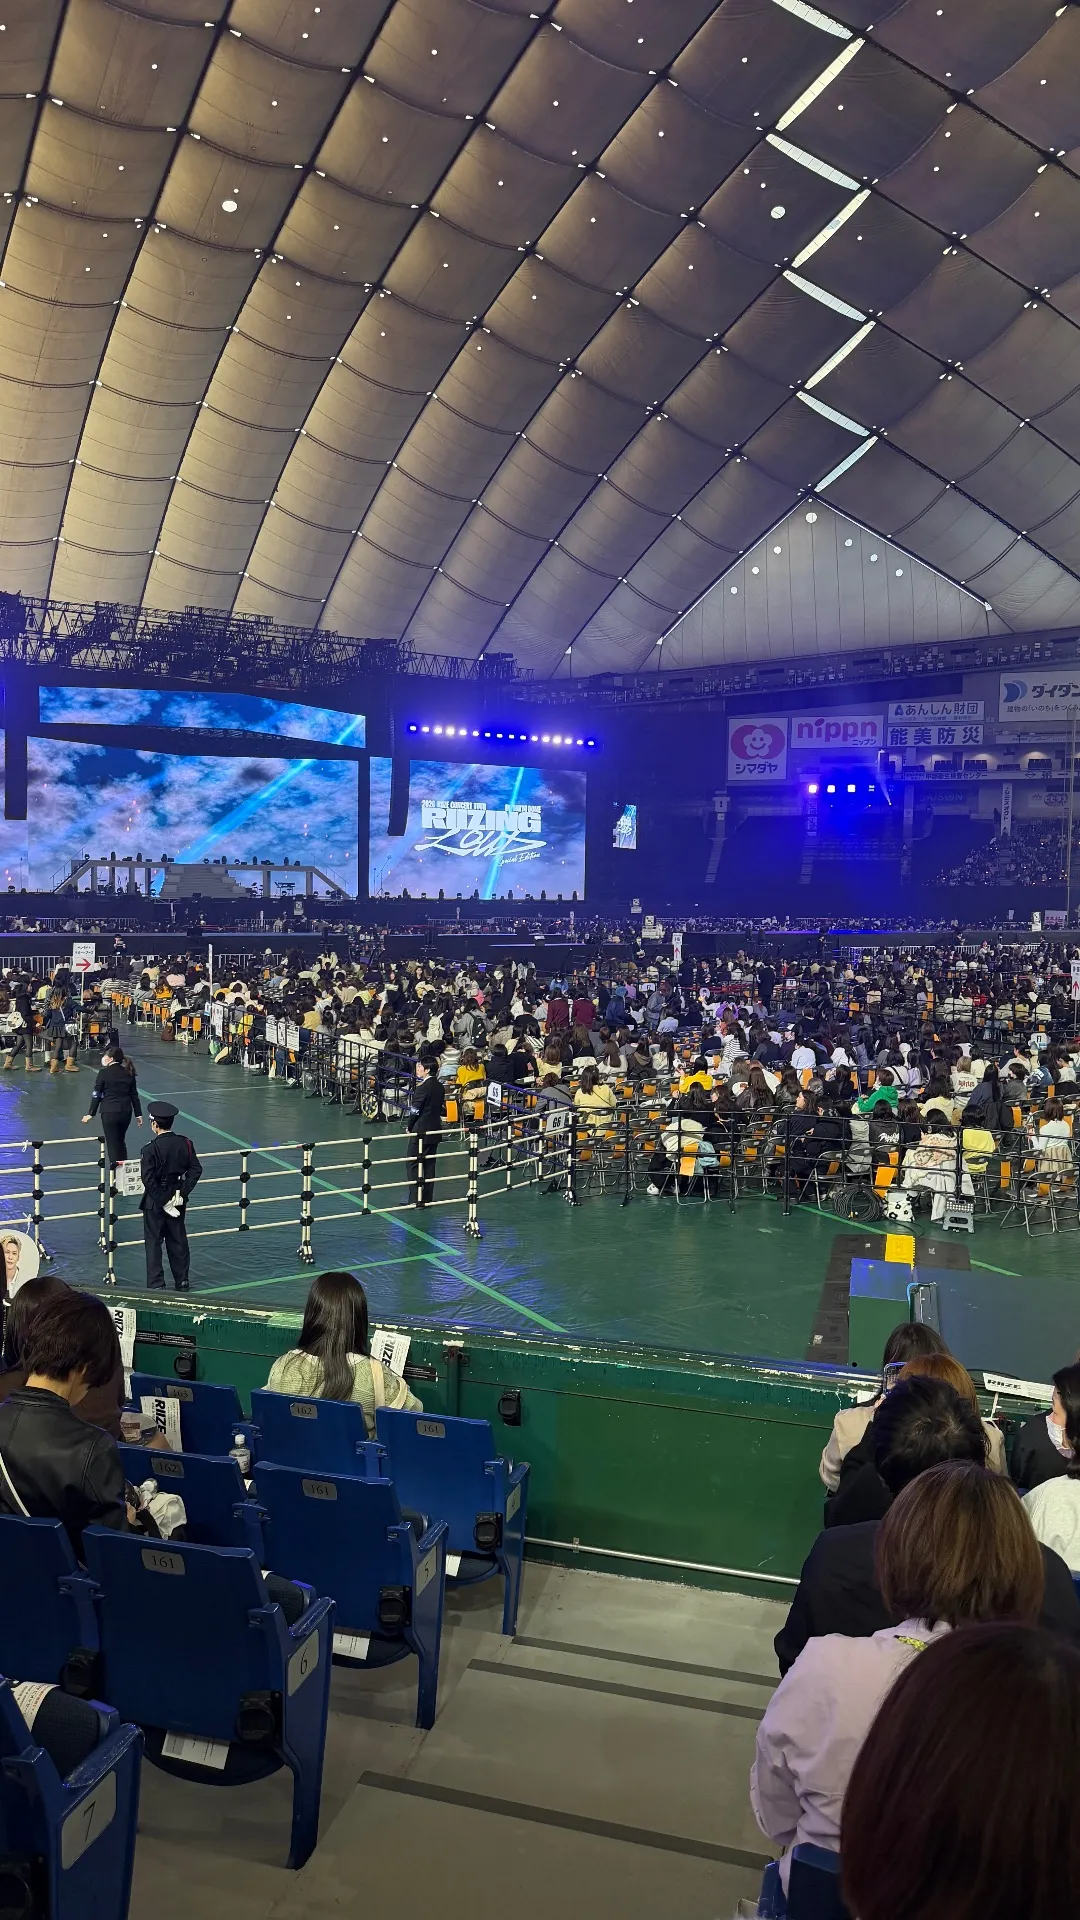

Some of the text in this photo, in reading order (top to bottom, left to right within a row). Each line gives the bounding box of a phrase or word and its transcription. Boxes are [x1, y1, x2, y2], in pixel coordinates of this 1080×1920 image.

[905, 702, 978, 716] あんしん財団
[797, 718, 878, 742] nippn
[890, 726, 980, 746] 能美防災
[852, 738, 877, 746] ニップン
[735, 762, 779, 775] シマダヤ
[422, 808, 541, 833] RIIZING
[154, 1398, 167, 1435] RIIZE
[295, 1406, 312, 1415] 162
[423, 1424, 439, 1434] 161
[160, 1462, 177, 1473] 162
[310, 1484, 330, 1496] 161
[151, 1555, 175, 1569] 161
[300, 1648, 308, 1675] 6
[83, 1800, 97, 1842] 7
